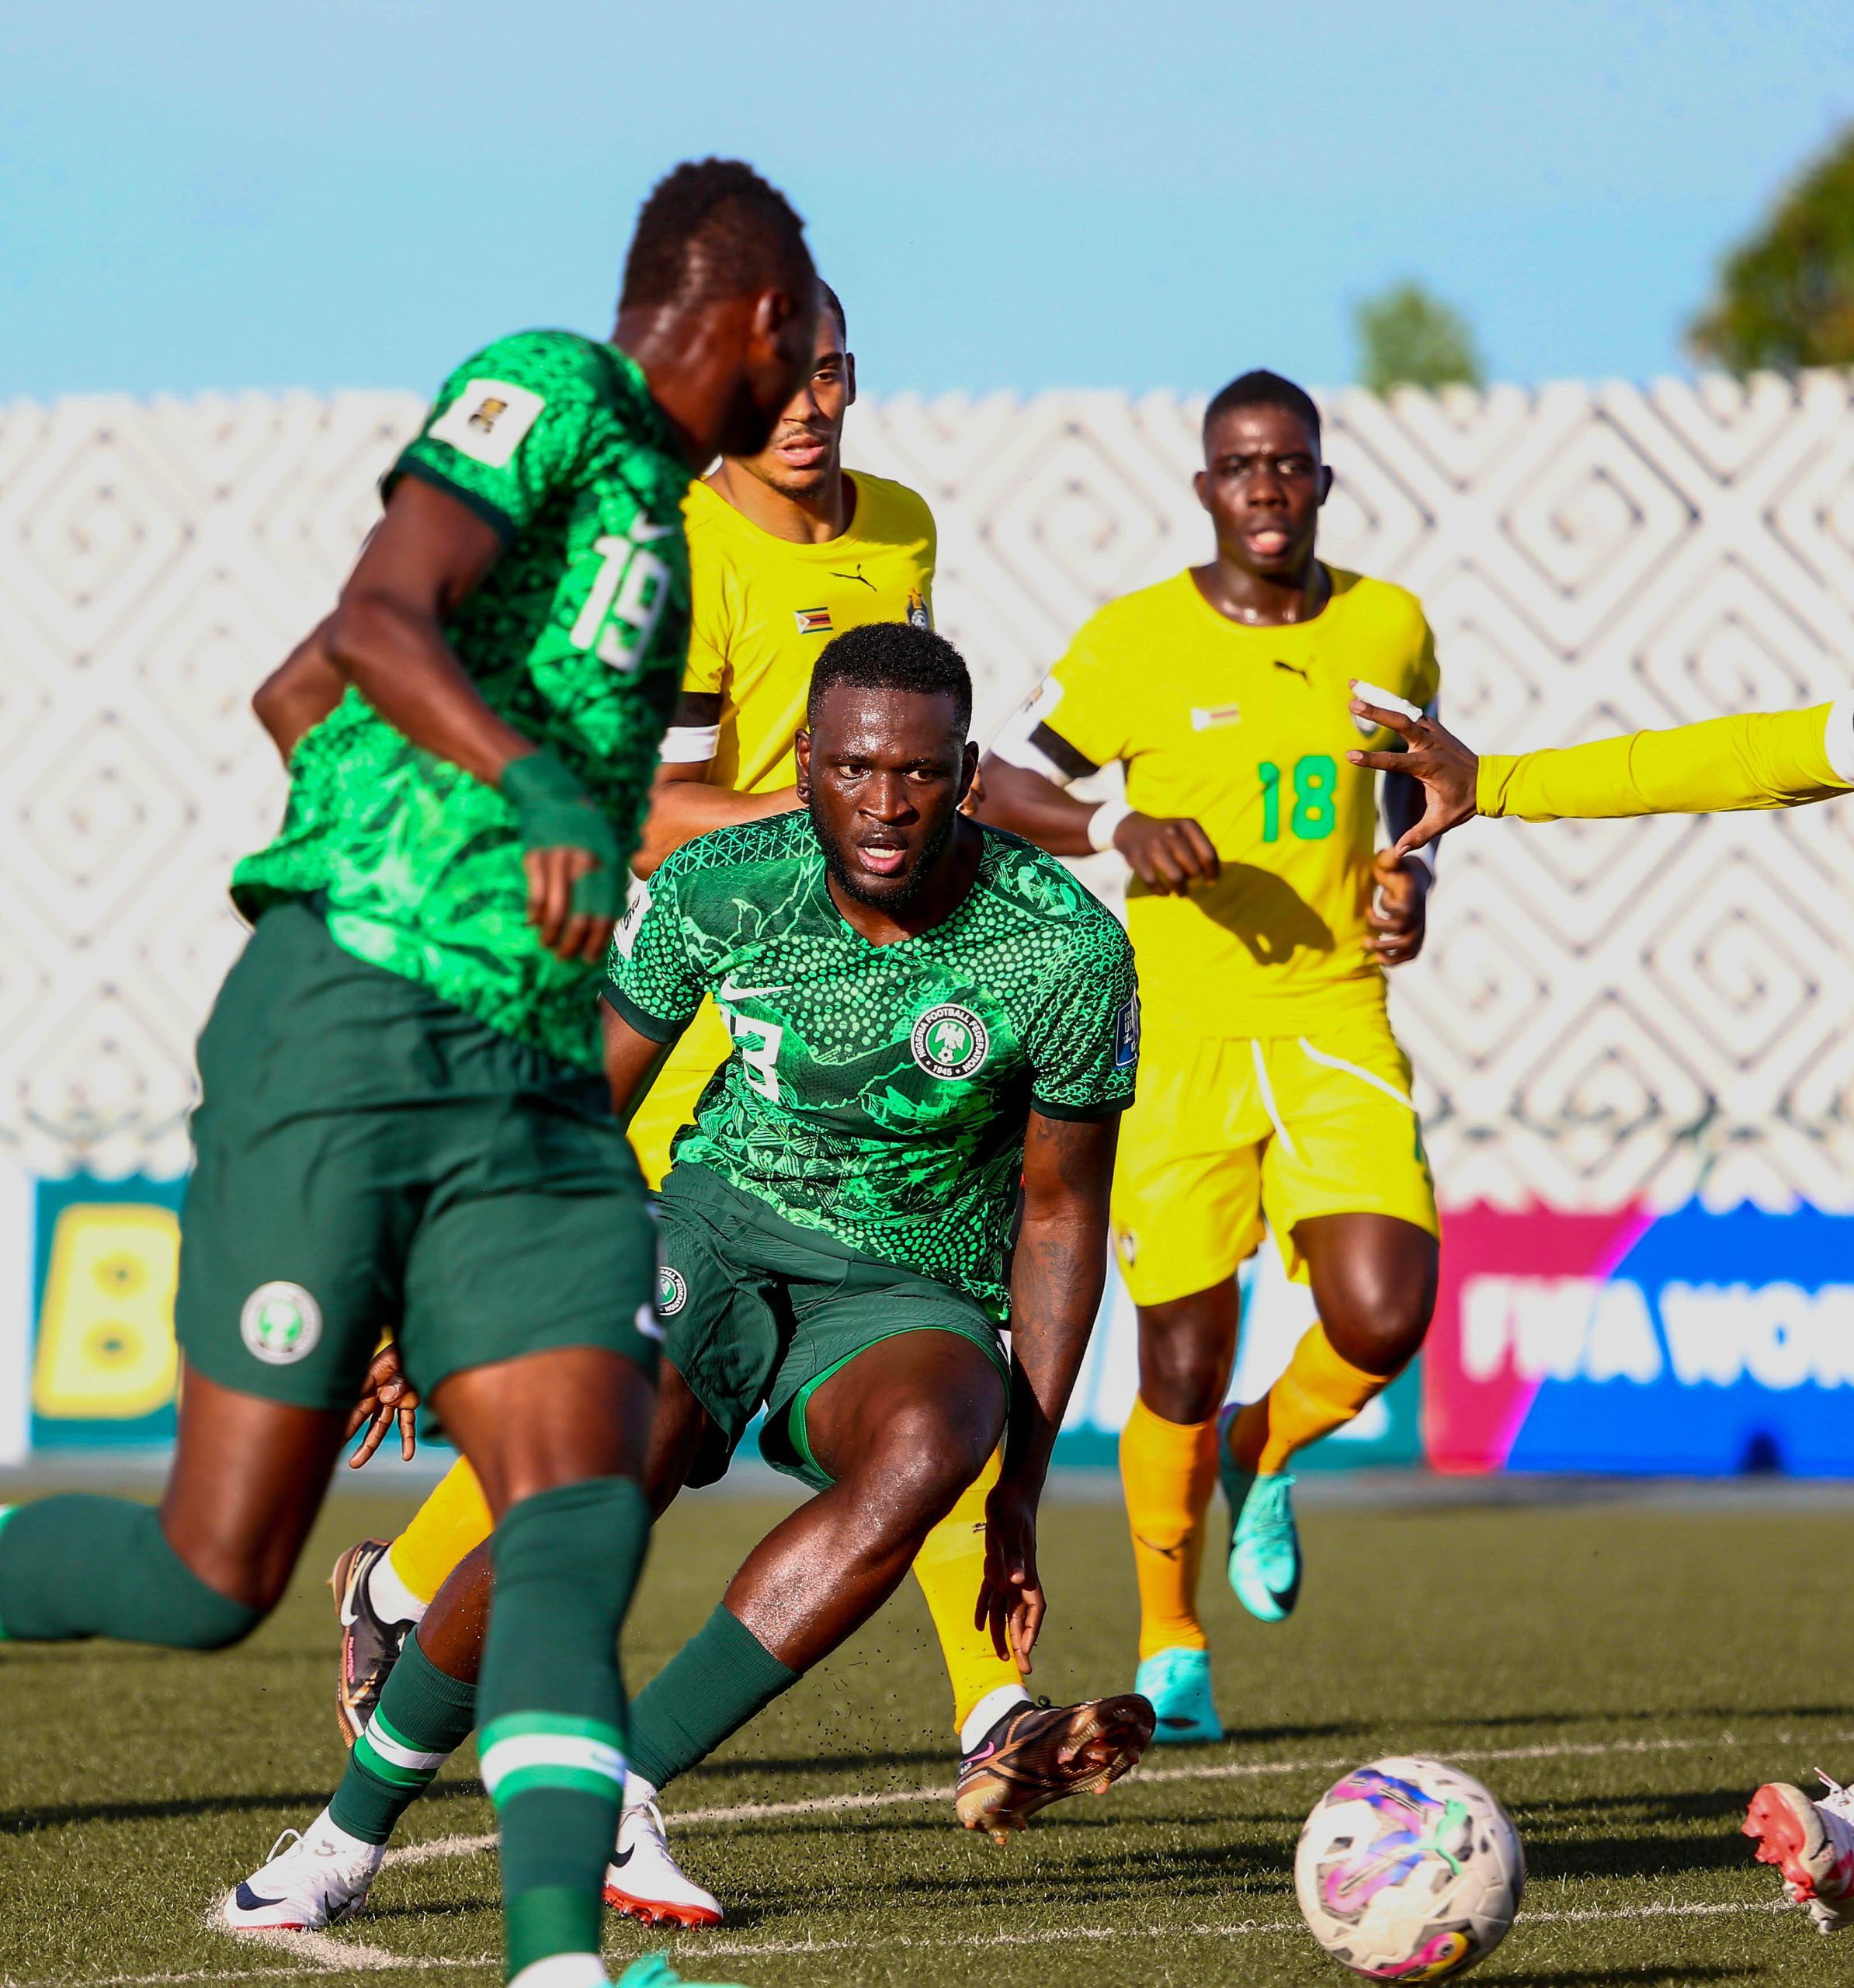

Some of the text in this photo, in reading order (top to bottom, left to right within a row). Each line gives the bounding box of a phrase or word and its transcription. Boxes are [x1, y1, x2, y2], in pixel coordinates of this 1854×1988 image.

[569, 536, 671, 674] 19
[1259, 755, 1337, 843] 18
[914, 1008, 984, 1072] NIGERIA FOOTBALL FEDERATION
[932, 1065, 953, 1076] 1945
[659, 1269, 684, 1312] BALL FEDERATION
